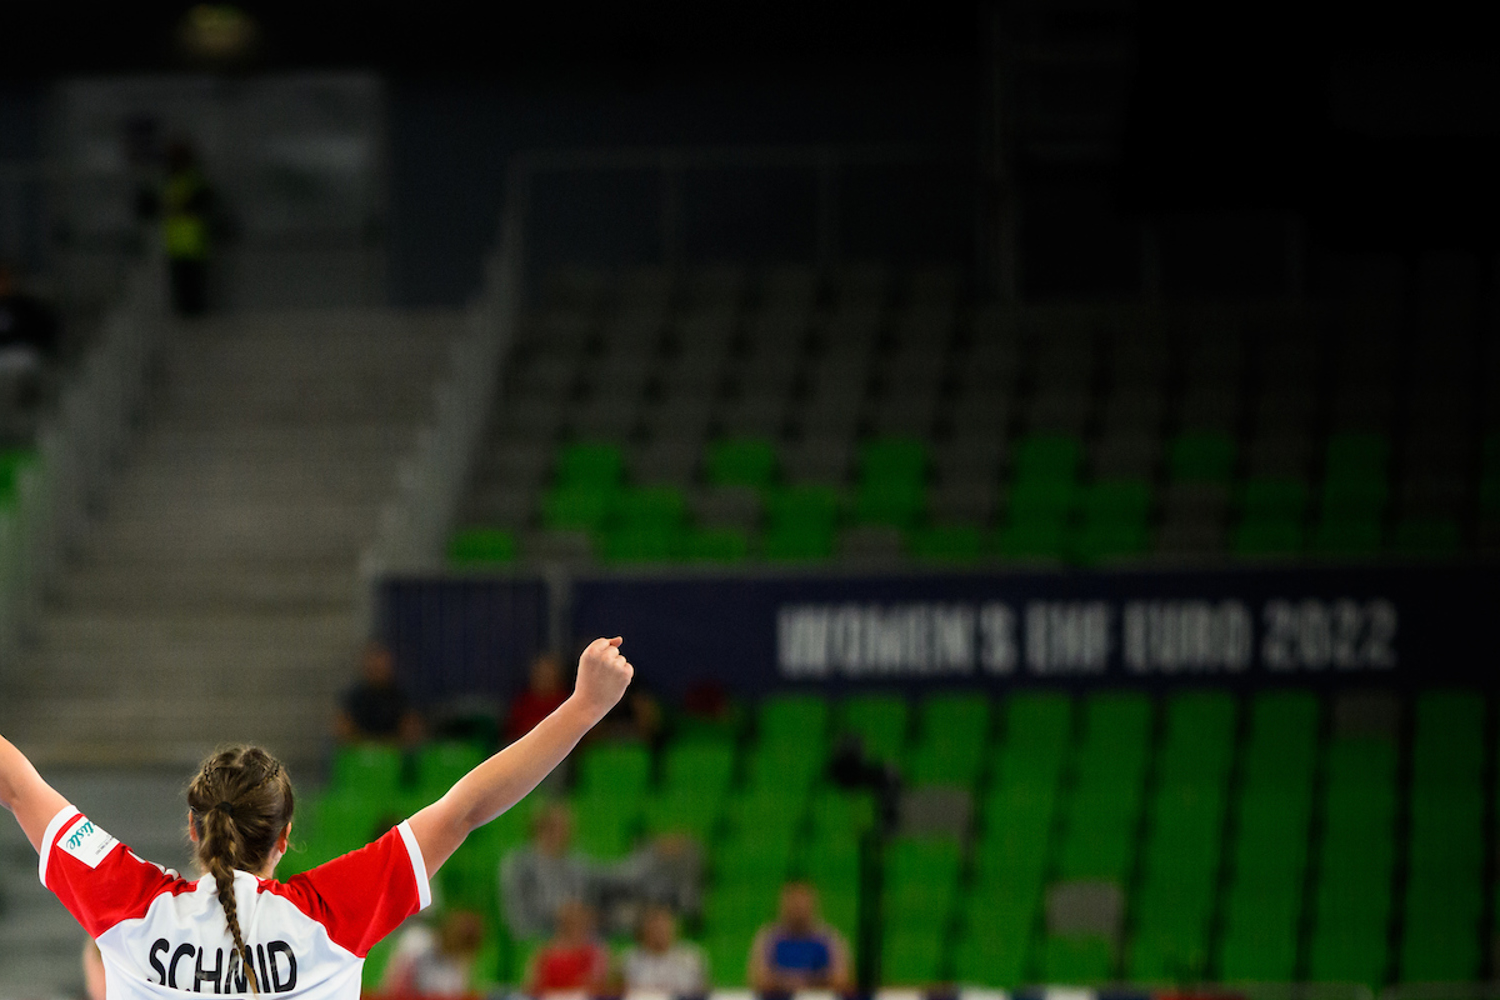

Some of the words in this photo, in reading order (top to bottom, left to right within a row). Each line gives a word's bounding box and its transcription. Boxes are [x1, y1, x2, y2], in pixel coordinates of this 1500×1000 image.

[776, 600, 1016, 677] WOMEN'S
[1123, 598, 1252, 674] EURO
[1262, 598, 1397, 673] 2022
[147, 938, 297, 994] SCHMID
